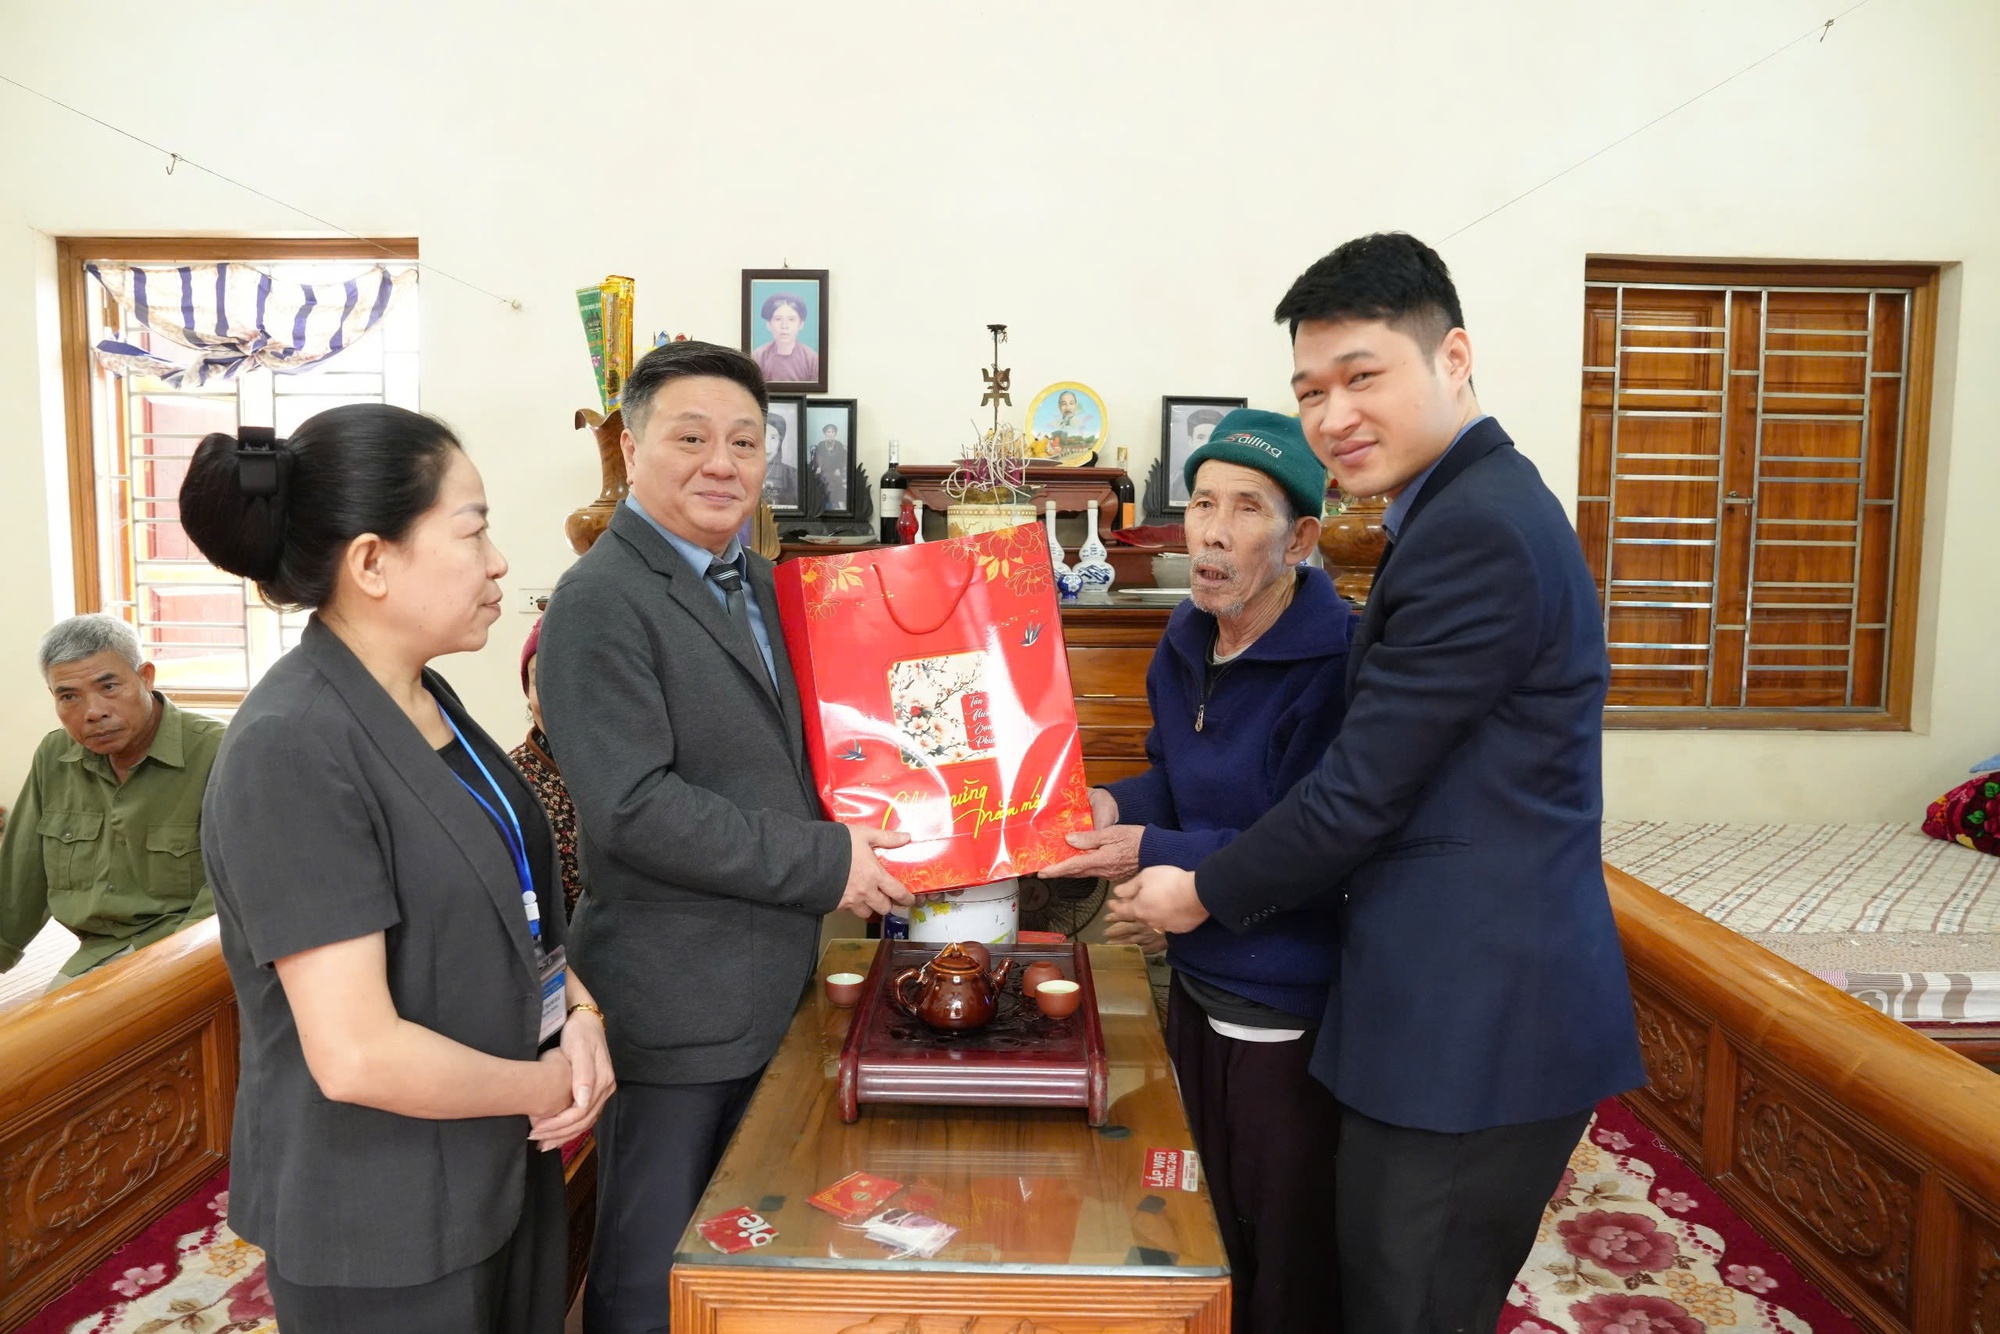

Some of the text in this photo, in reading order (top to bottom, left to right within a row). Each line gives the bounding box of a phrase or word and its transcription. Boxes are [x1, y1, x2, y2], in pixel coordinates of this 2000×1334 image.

[1145, 1152, 1166, 1187] LẮP WIFI
[1165, 1152, 1177, 1187] TRONG 24H
